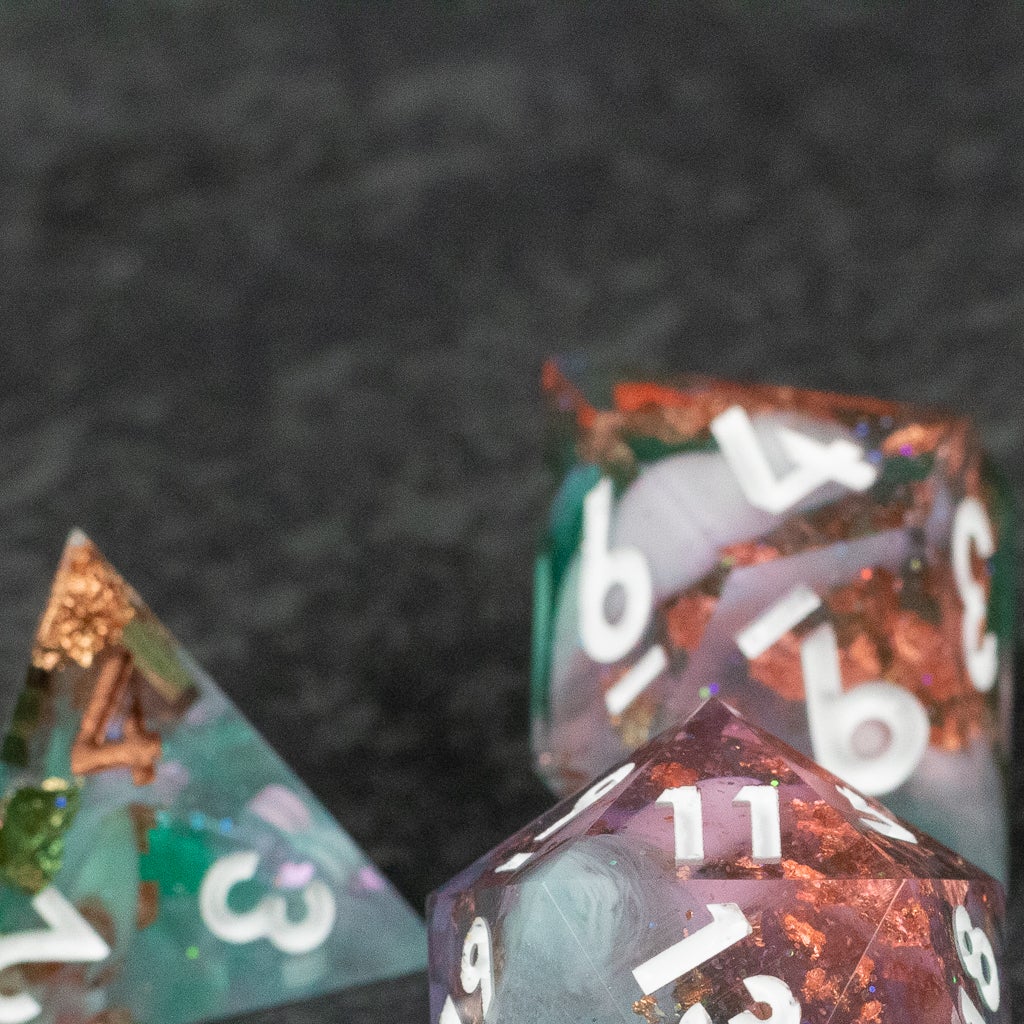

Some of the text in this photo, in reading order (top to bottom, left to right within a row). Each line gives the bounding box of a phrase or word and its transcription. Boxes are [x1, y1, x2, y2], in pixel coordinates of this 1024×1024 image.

[711, 404, 877, 514] 4
[70, 650, 162, 786] 4
[656, 785, 781, 863] 11
[200, 851, 337, 956] 3
